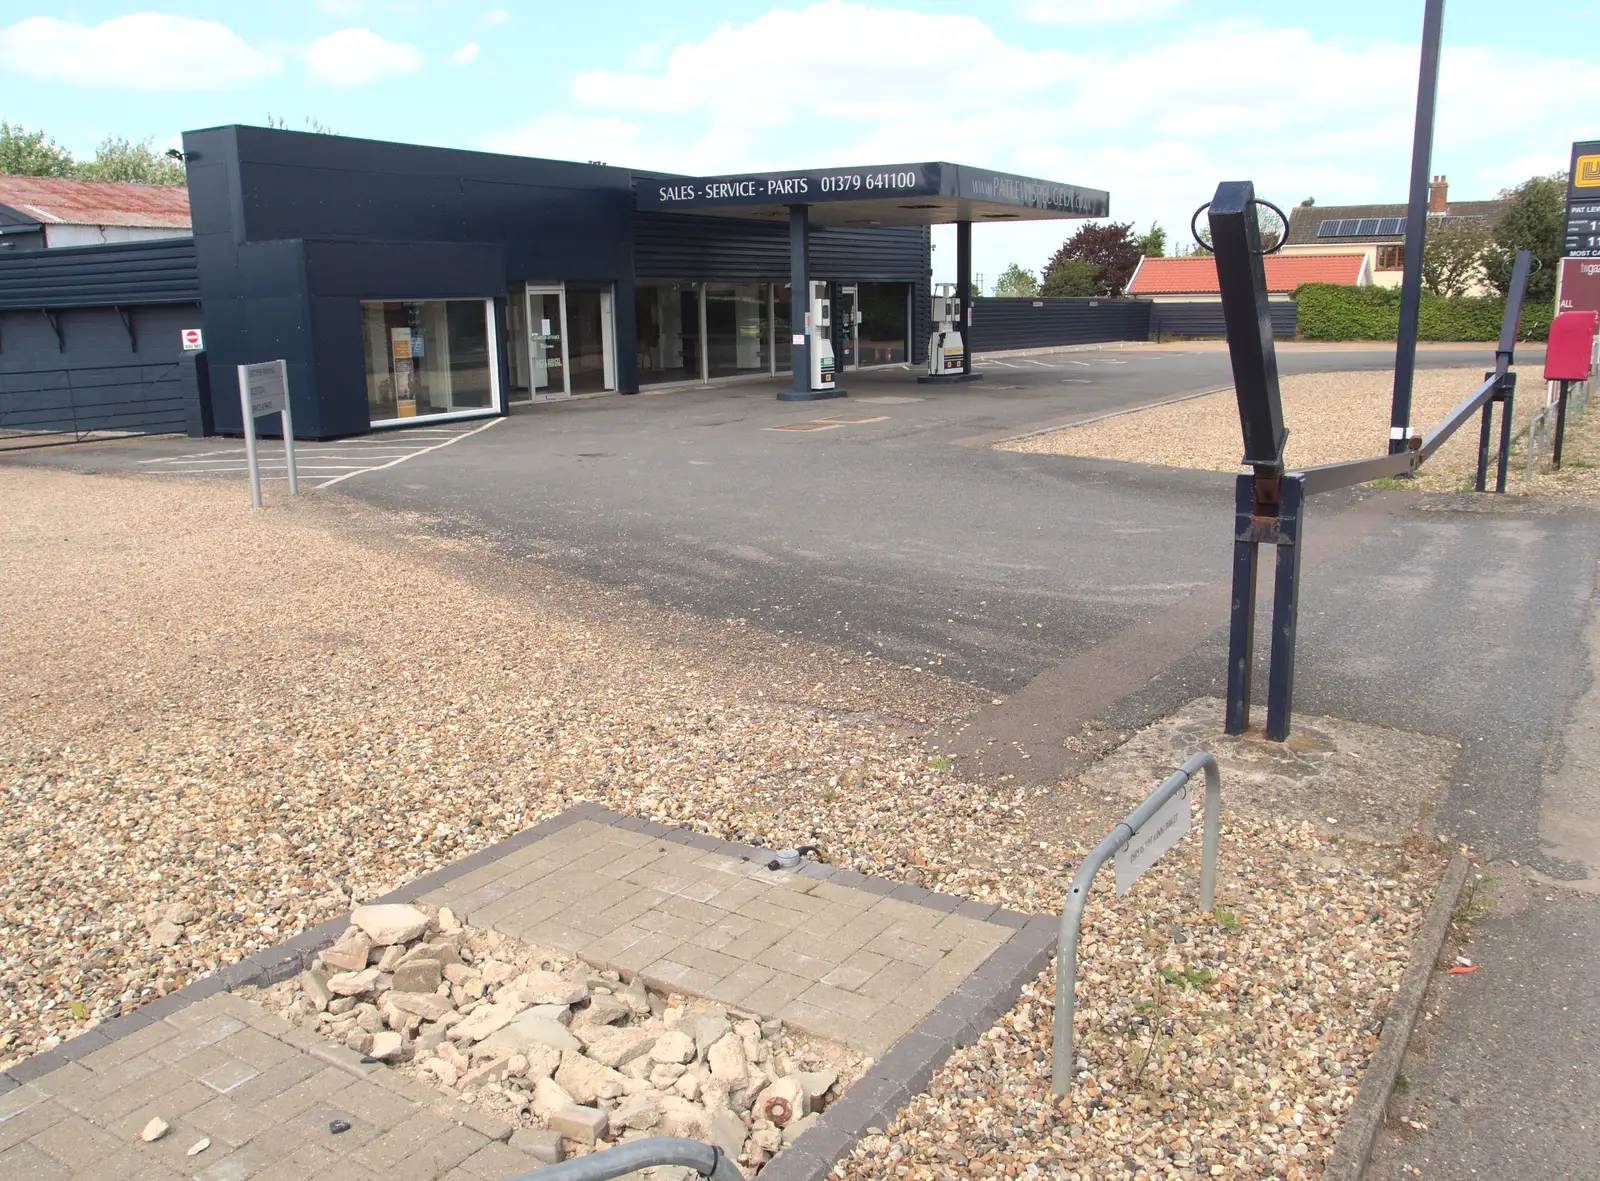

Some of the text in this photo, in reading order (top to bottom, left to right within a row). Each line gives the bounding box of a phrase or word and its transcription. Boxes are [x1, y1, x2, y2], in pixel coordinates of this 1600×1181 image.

[659, 186, 694, 201] SALES
[705, 181, 756, 198] SERVICE
[767, 178, 808, 195] PARTS
[821, 175, 861, 192] 01379
[866, 172, 916, 190] 641100
[1560, 299, 1573, 308] ALL
